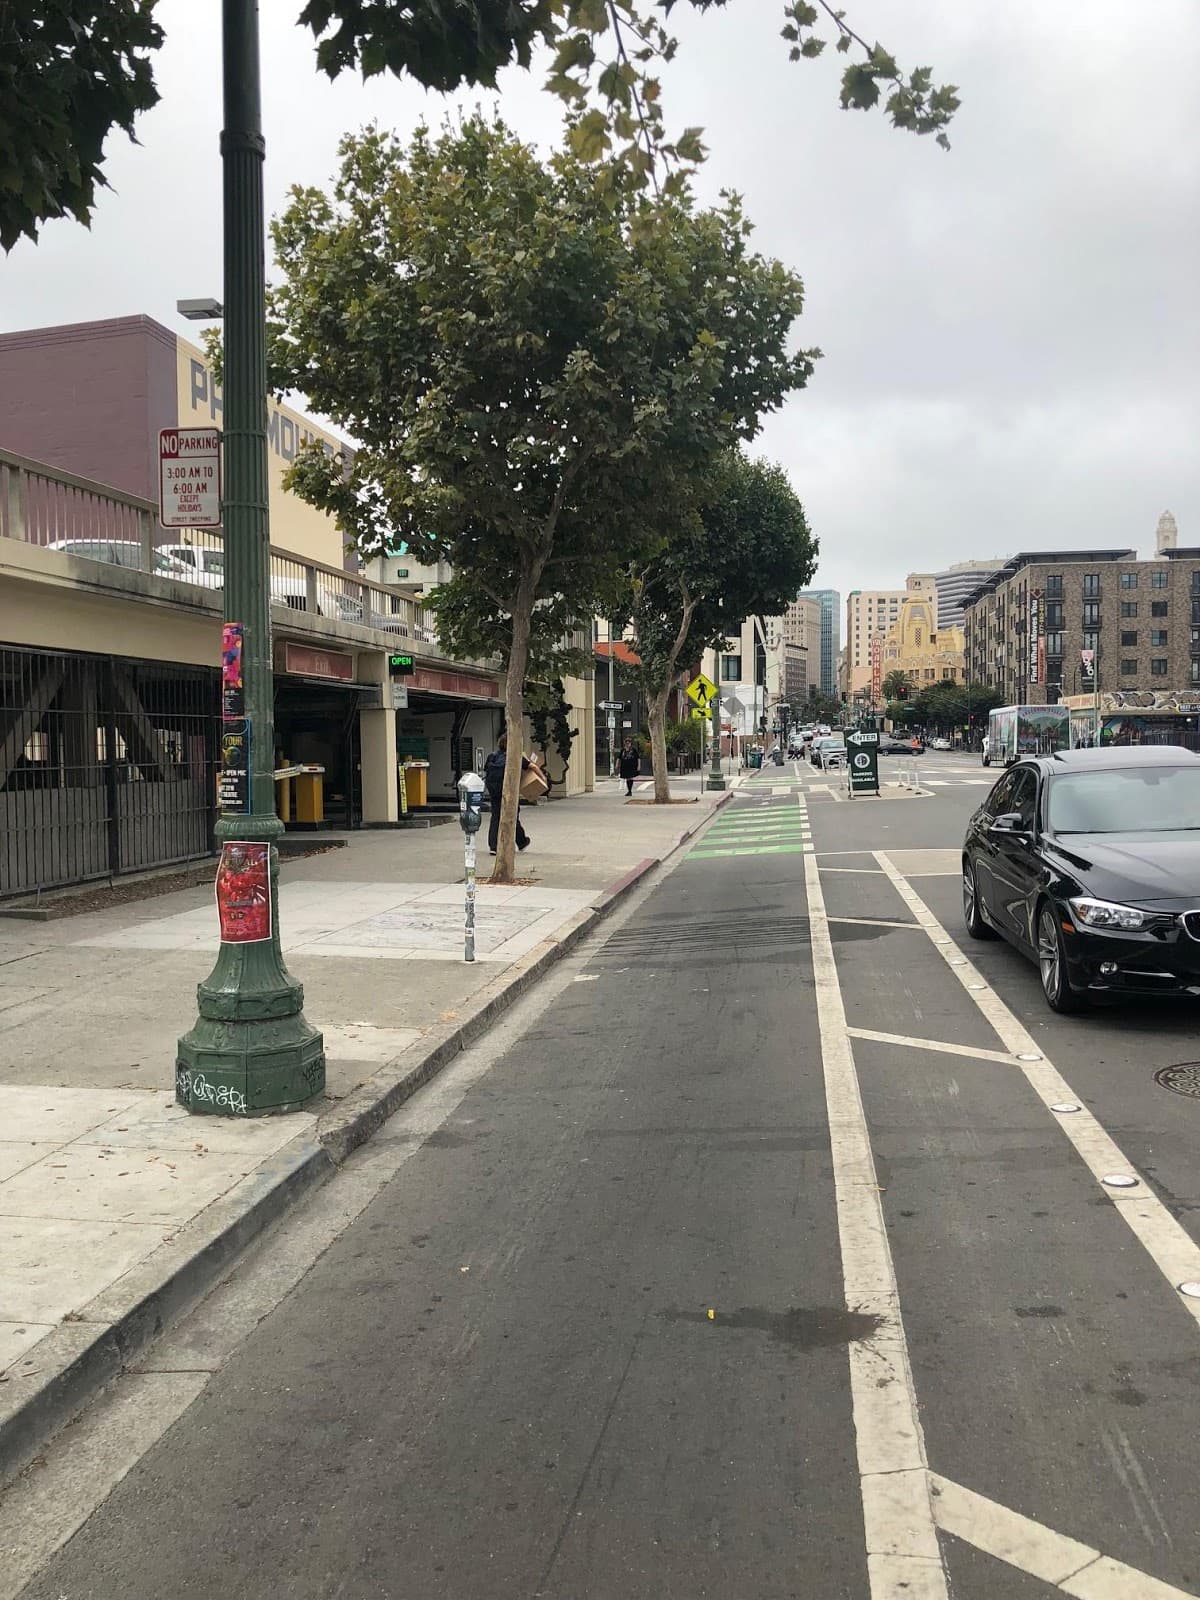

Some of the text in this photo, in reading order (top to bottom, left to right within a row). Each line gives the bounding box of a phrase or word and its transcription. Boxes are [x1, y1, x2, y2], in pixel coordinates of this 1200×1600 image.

[161, 435, 218, 454] NO PARKING
[167, 466, 213, 479] 3:00 AM TO
[173, 482, 208, 494] 6:00 AM
[179, 494, 199, 503] EXCEPT
[177, 503, 202, 512] HOLIDAYS
[1030, 599, 1038, 682] Find What Moves You
[391, 656, 412, 666] OPEN
[224, 735, 243, 746] YOUR
